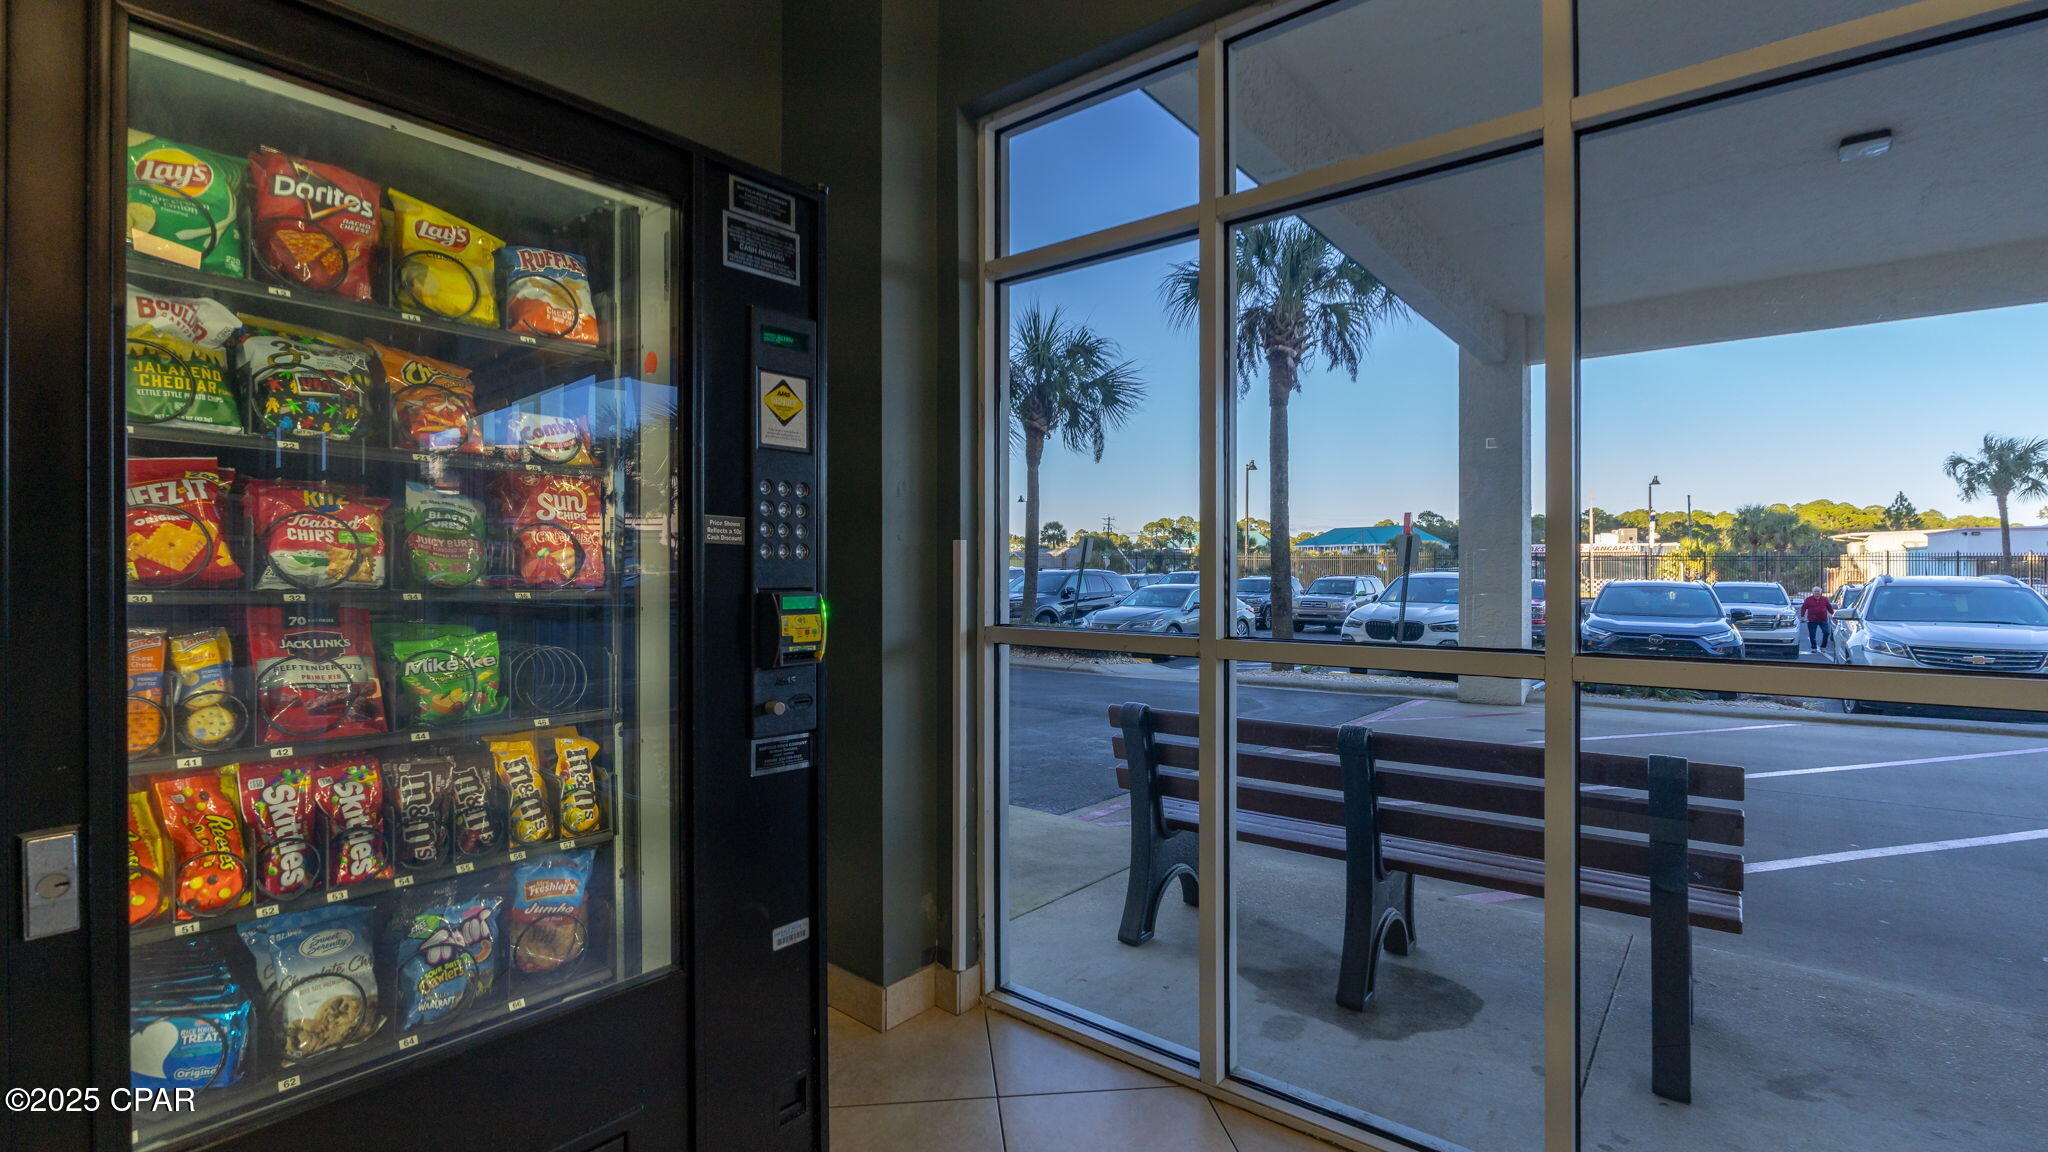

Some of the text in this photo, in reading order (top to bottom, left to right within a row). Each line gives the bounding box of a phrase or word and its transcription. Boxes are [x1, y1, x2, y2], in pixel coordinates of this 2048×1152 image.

[141, 160, 208, 188] Lay's
[274, 174, 374, 218] Doritos
[340, 223, 370, 234] CHEESE
[418, 221, 468, 246] Lay's
[162, 390, 182, 399] STYLE
[536, 492, 587, 520] Sun
[557, 509, 587, 521] CHIPS
[287, 515, 361, 530] Toasted
[286, 528, 335, 543] CHIPS
[288, 616, 307, 626] 70
[279, 639, 312, 649] JACK
[405, 657, 459, 677] Mike
[275, 749, 289, 757] 42
[183, 759, 197, 767] 41
[261, 908, 275, 916] 52
[524, 902, 575, 915] Jumbo
[181, 924, 195, 934] 51
[309, 931, 341, 948] Sweet
[307, 940, 348, 955] Serenity
[403, 1037, 415, 1046] 64
[283, 1078, 297, 1088] 62
